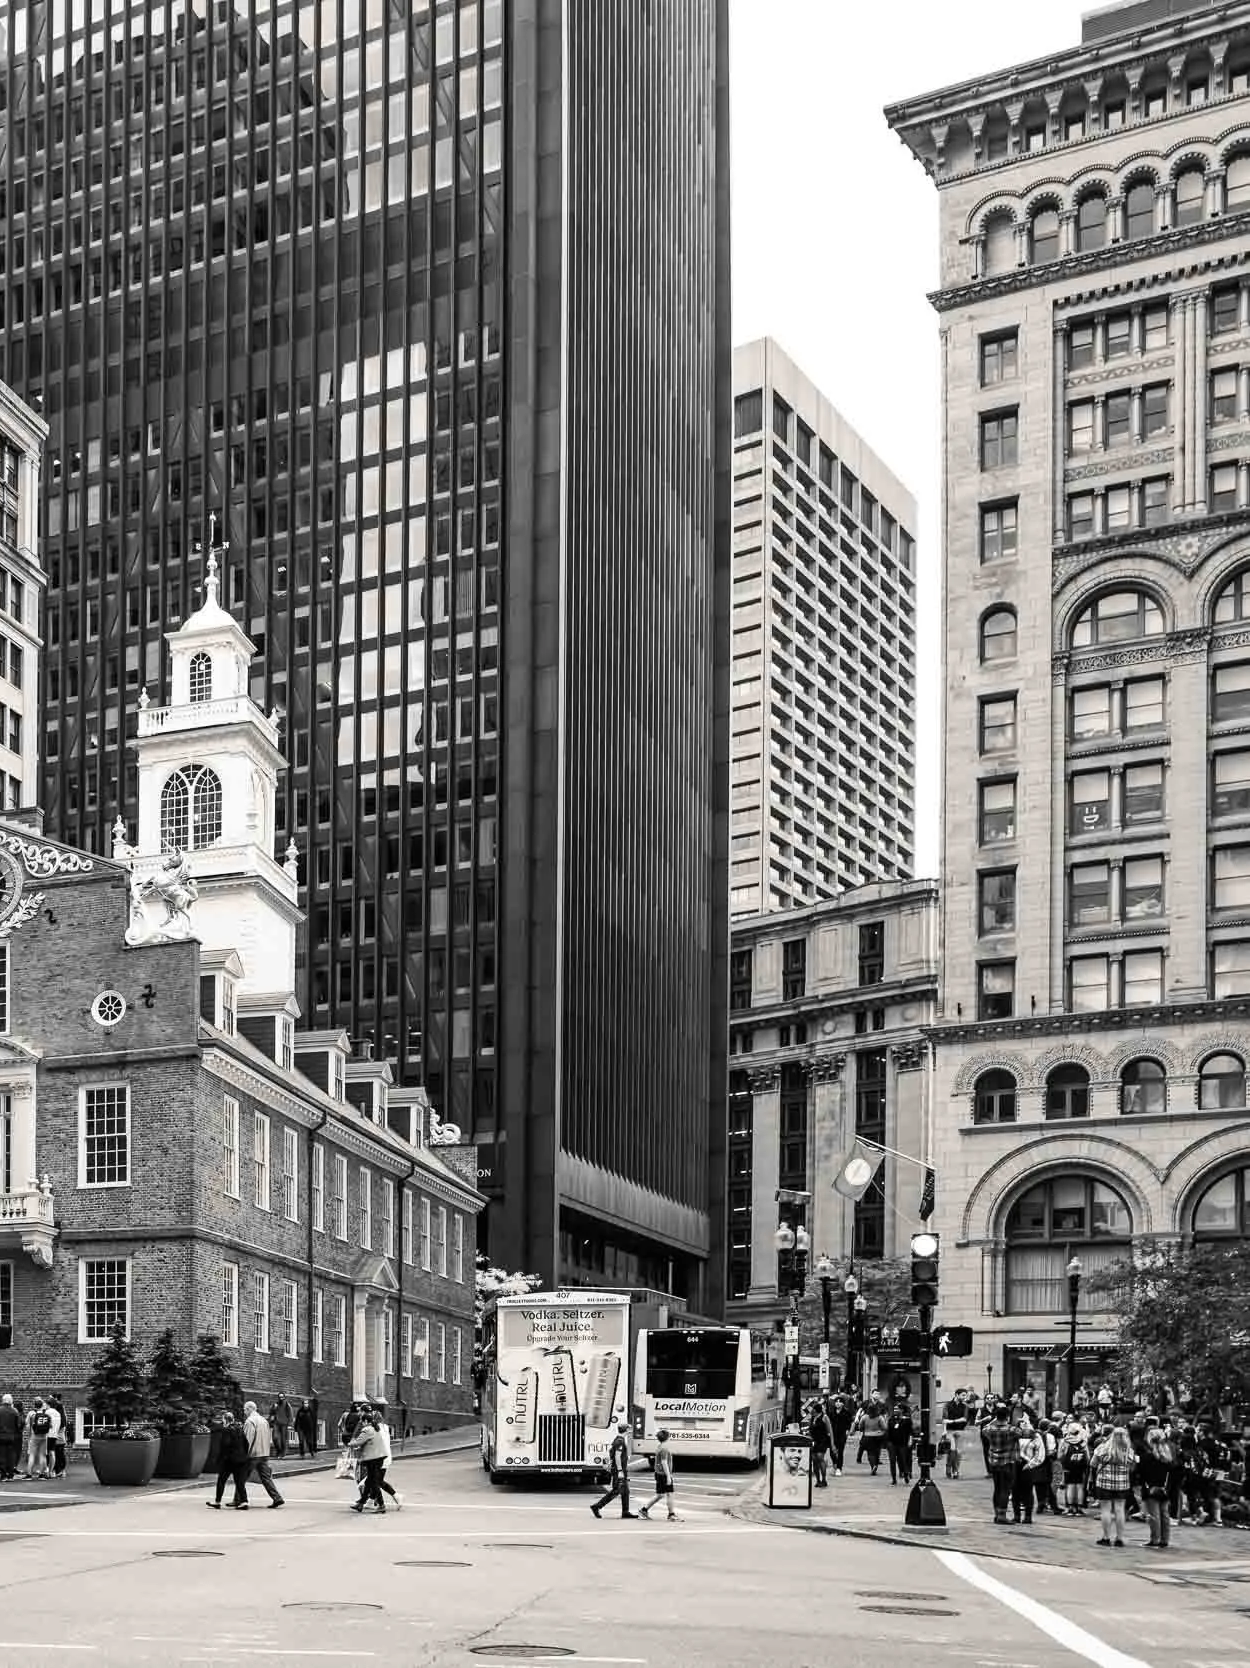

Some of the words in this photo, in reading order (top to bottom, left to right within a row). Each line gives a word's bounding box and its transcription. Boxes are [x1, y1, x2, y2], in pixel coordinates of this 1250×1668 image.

[555, 1291, 571, 1300] 407
[521, 1311, 560, 1320] Vodka.
[562, 1310, 605, 1320] Seltzer.
[532, 1322, 557, 1332] Real
[559, 1321, 594, 1332] Juice.
[526, 1335, 556, 1343] Upgrade
[654, 1401, 727, 1412] LocalMotion
